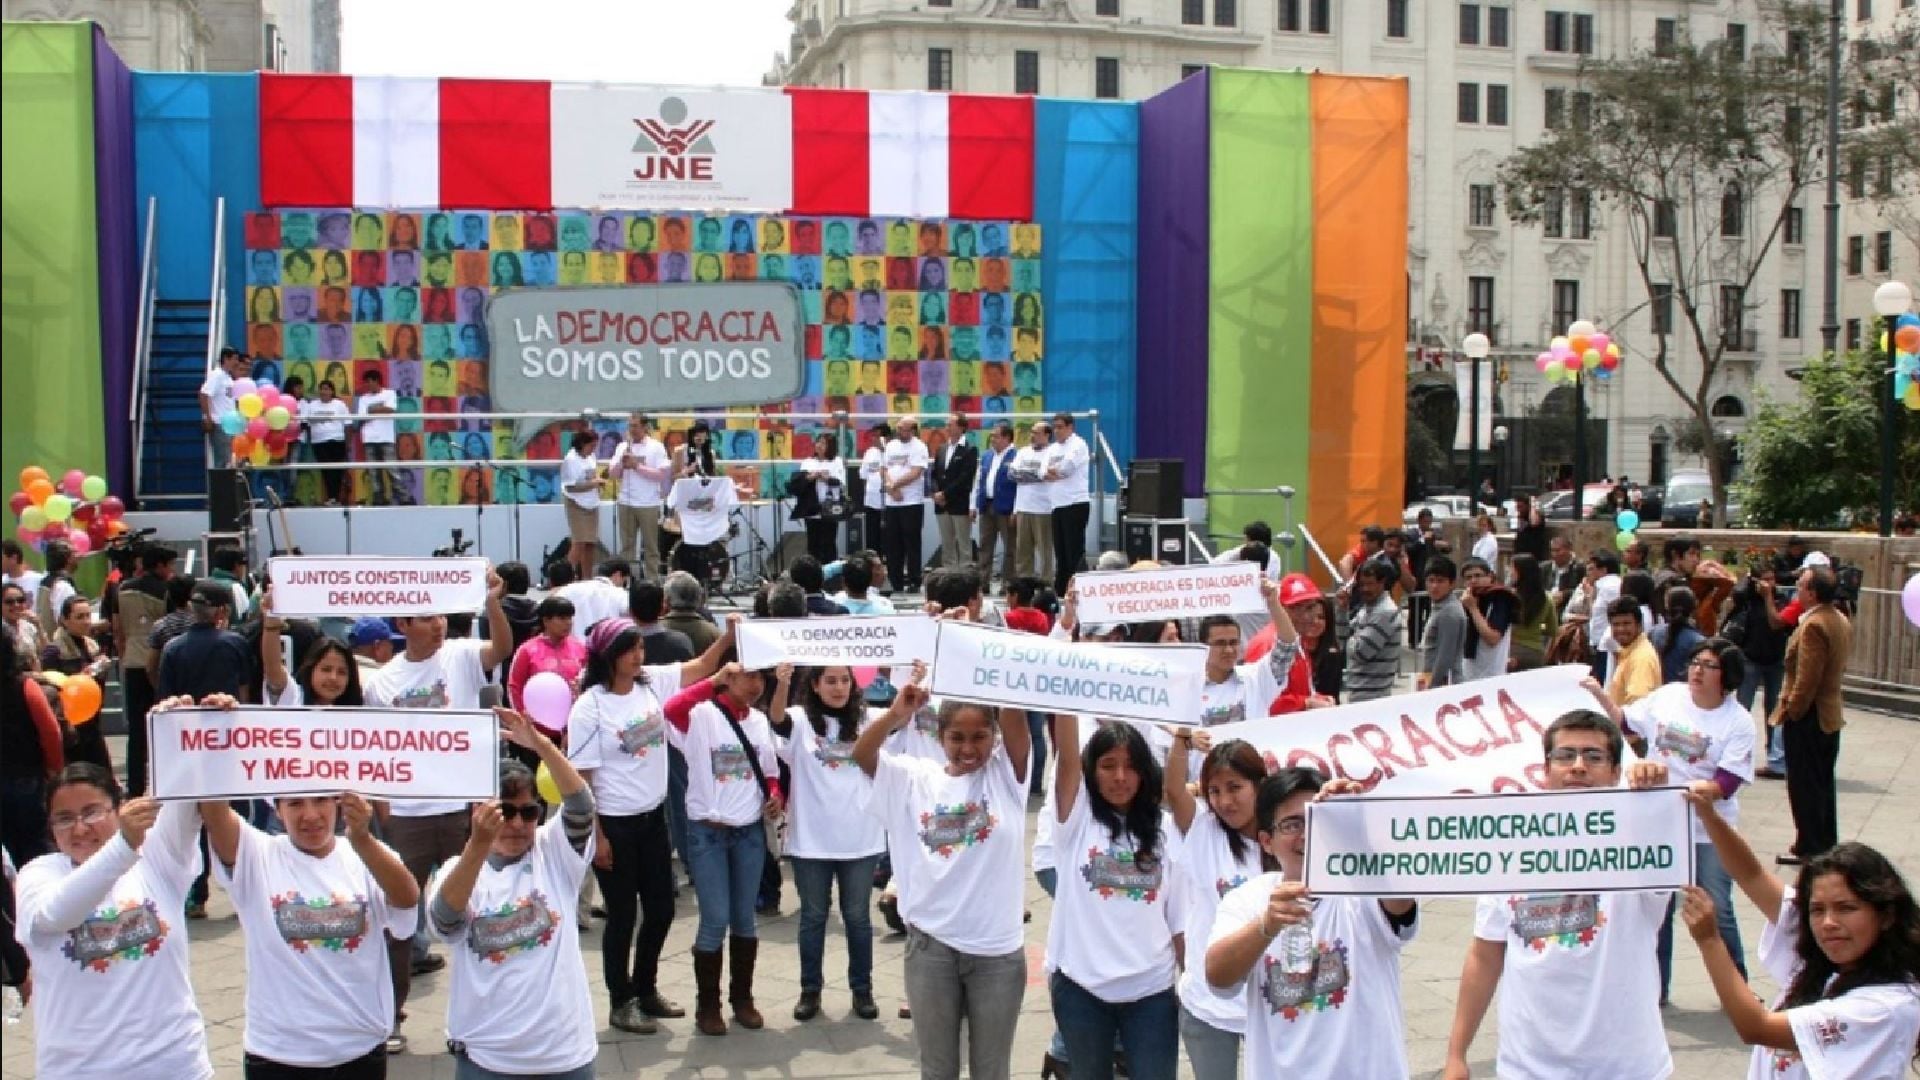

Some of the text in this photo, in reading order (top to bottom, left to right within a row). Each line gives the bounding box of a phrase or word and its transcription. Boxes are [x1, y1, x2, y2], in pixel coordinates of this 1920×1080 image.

[633, 157, 713, 181] JNE
[514, 310, 781, 345] LA DEMOCRACIA
[521, 347, 772, 382] SOMOS TODOS
[287, 570, 472, 585] JUNTOS CONSTRUIMOS
[1082, 574, 1254, 597] LA DEMOCRACIA ES DIALOGAR
[328, 590, 432, 605] DEMOCRACIA
[1107, 594, 1231, 614] Y ESCUCHAR AL OTRO
[780, 626, 897, 641] LA DEMOCRACIA
[788, 645, 895, 657] SOMOS TODOS
[979, 641, 1005, 660] YO
[1010, 644, 1052, 665] SOY
[1058, 651, 1100, 671] UNA
[973, 667, 1170, 708] DE LA DEMOCRACIA
[181, 727, 470, 752] MEJORES CIUDADANOS
[242, 757, 412, 782] Y MEJOR PAÍS
[1390, 810, 1615, 841] LA DEMOCRACIA ES
[1326, 844, 1673, 876] COMPROMISO Y SOLIDARIDAD
